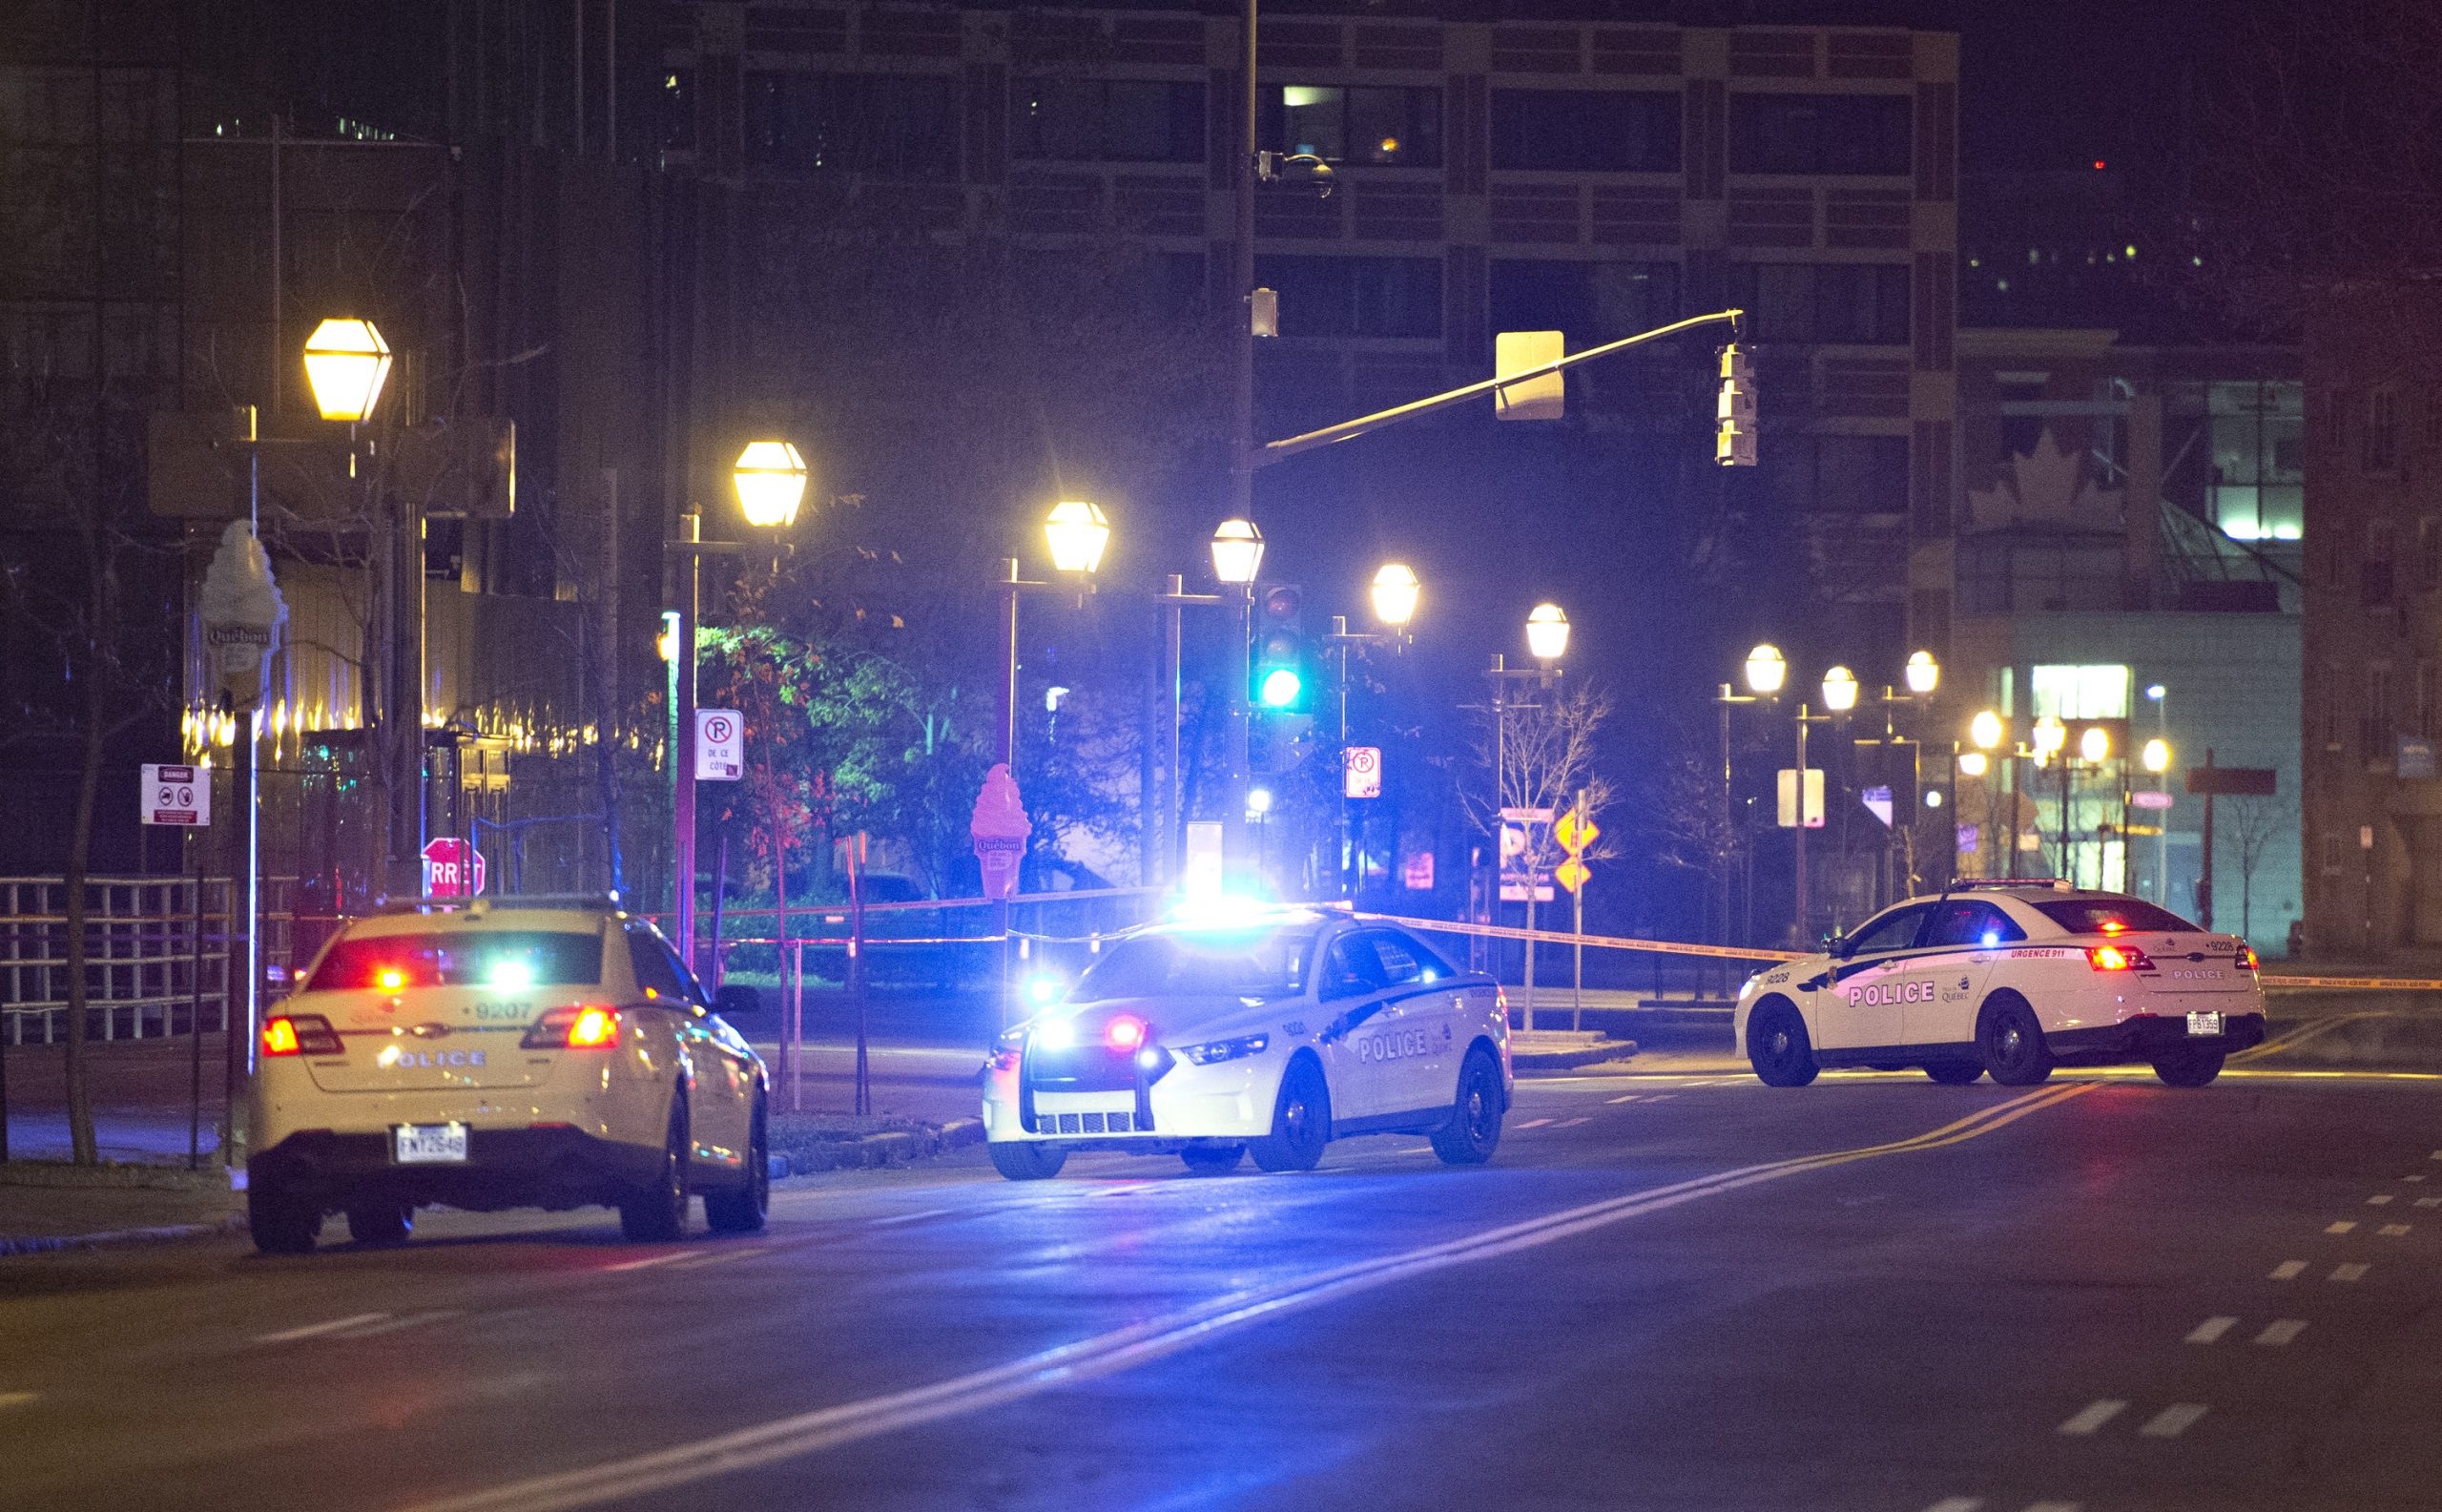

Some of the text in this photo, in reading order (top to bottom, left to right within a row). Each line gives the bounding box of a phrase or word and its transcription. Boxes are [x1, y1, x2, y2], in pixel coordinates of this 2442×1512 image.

[2011, 949, 2050, 958] URGENCE
[1767, 972, 1790, 984] 9228
[2174, 970, 2224, 979] POLICE
[1849, 981, 1935, 1007] POLICE
[477, 1003, 532, 1019] 9207
[1358, 1029, 1427, 1064] POLICE
[378, 1050, 486, 1067] OLICE
